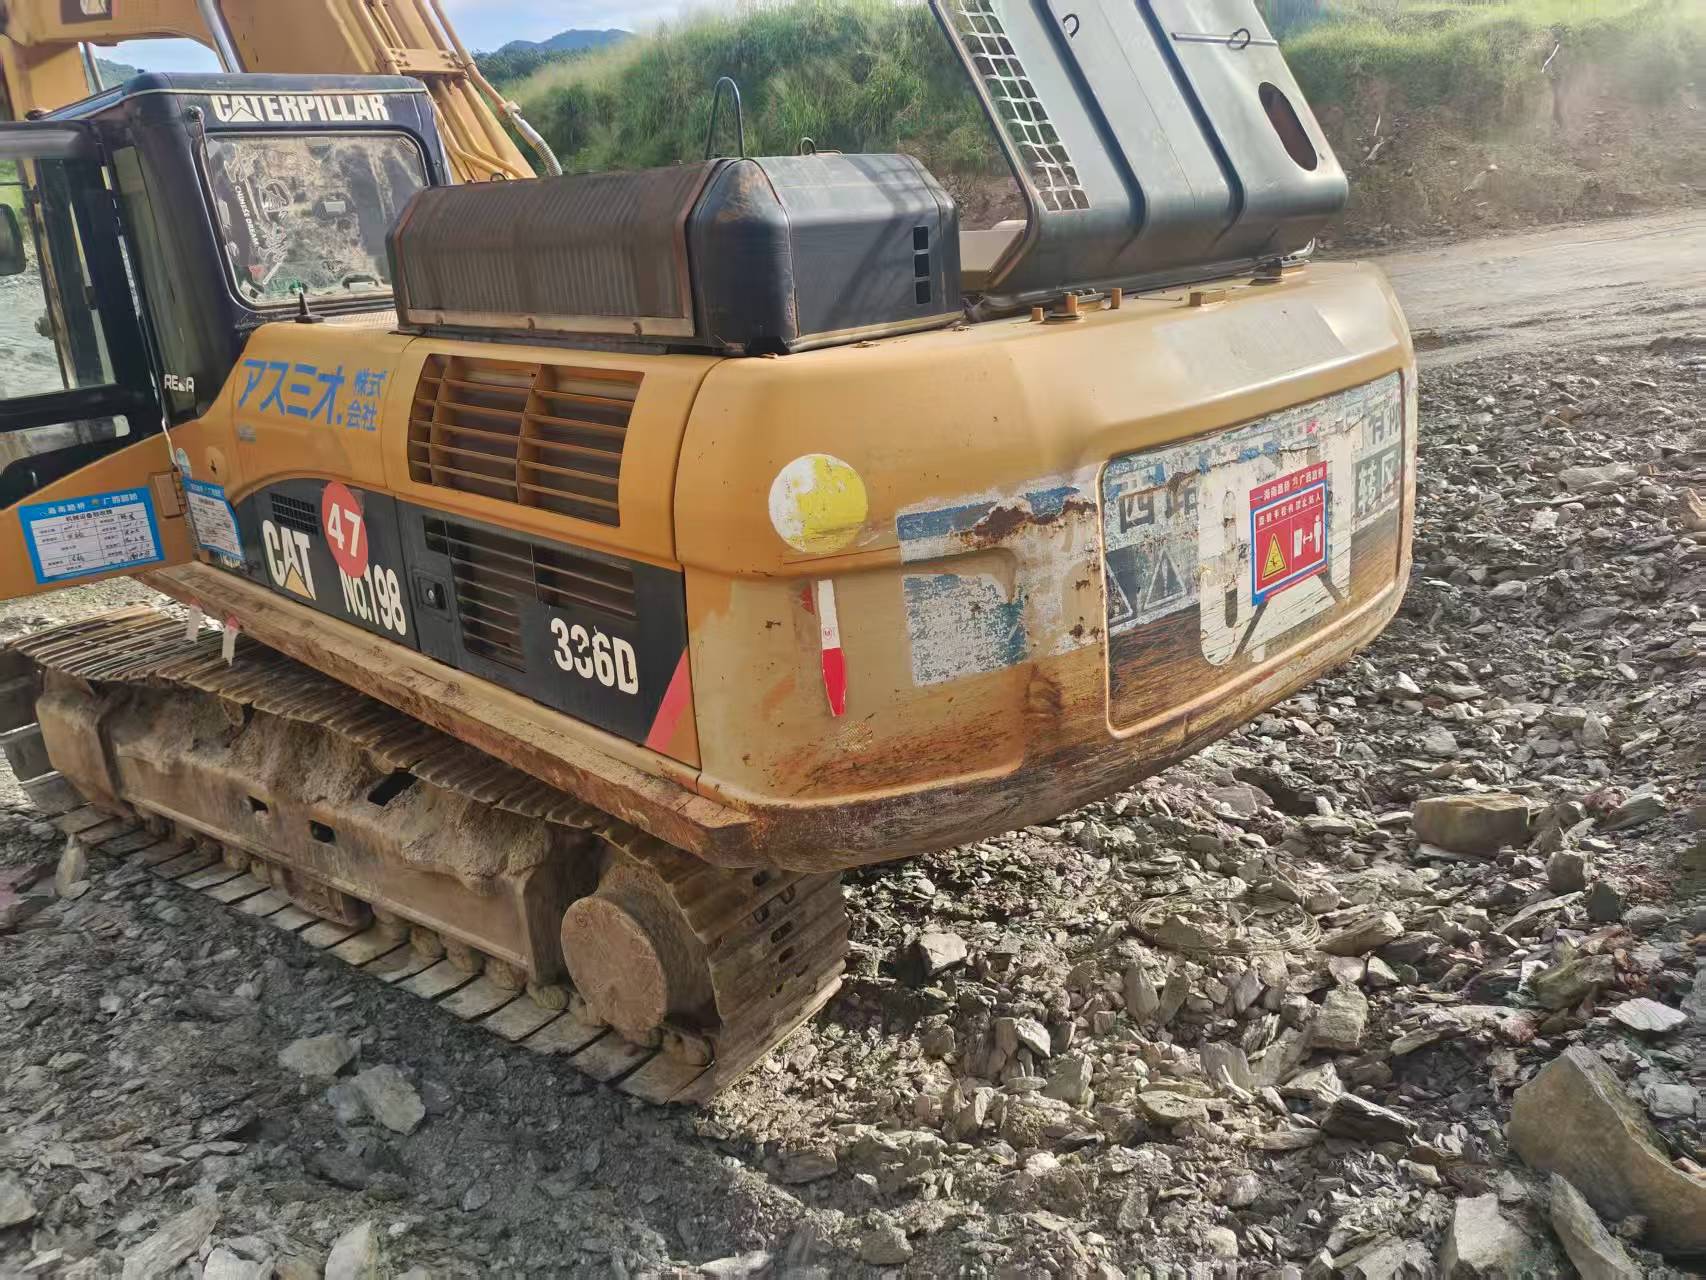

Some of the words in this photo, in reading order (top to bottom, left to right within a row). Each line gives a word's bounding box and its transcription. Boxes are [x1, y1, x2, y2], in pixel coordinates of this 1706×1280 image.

[210, 94, 390, 123] CATERPILLAR
[262, 519, 317, 601] CAT
[327, 502, 361, 559] 47
[550, 617, 639, 695] 336D
